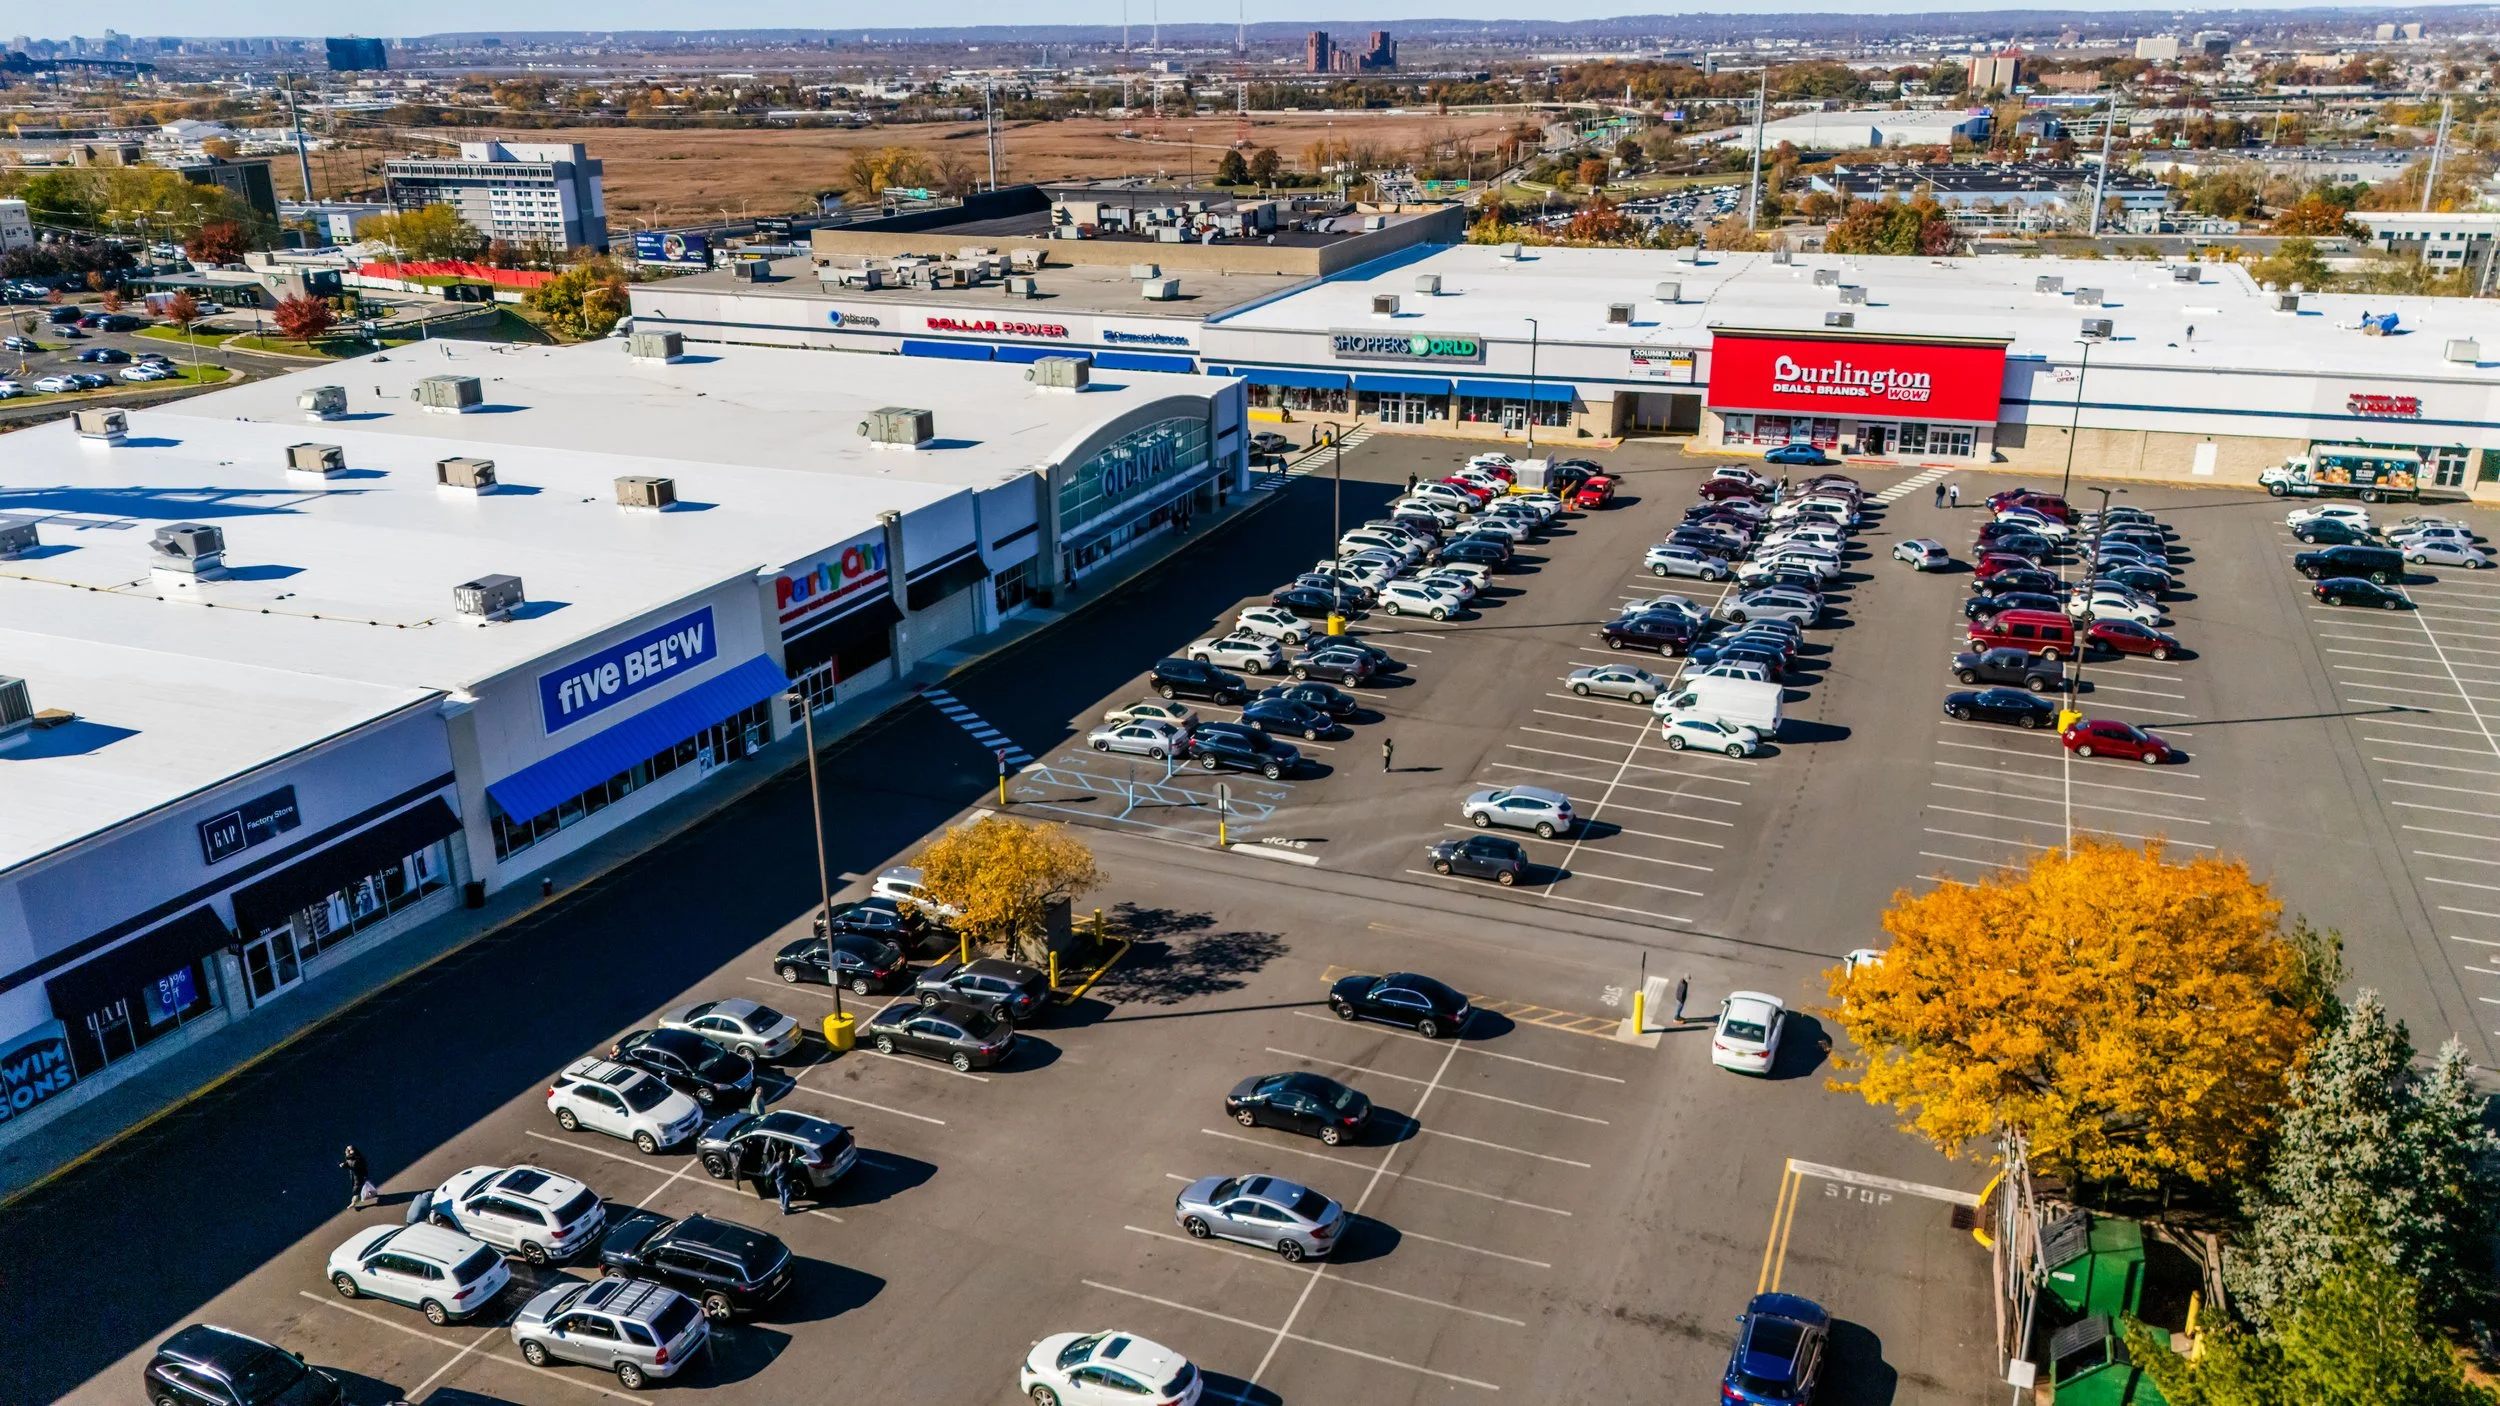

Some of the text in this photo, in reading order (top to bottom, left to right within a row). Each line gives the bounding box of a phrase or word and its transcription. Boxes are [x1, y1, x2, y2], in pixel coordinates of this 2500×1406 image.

[927, 318, 1063, 335] DOLLAR POWER
[1775, 355, 1930, 394] Burlington
[1773, 383, 1869, 397] DEALS. BRANDS.
[1889, 388, 1929, 401] WOW!
[1102, 461, 1134, 498] OLD
[558, 663, 620, 714] five
[213, 806, 293, 848] GAP Factory Store
[1262, 836, 1308, 849] STOP
[0, 1042, 65, 1093] WIM
[1825, 1182, 1893, 1206] STOP
